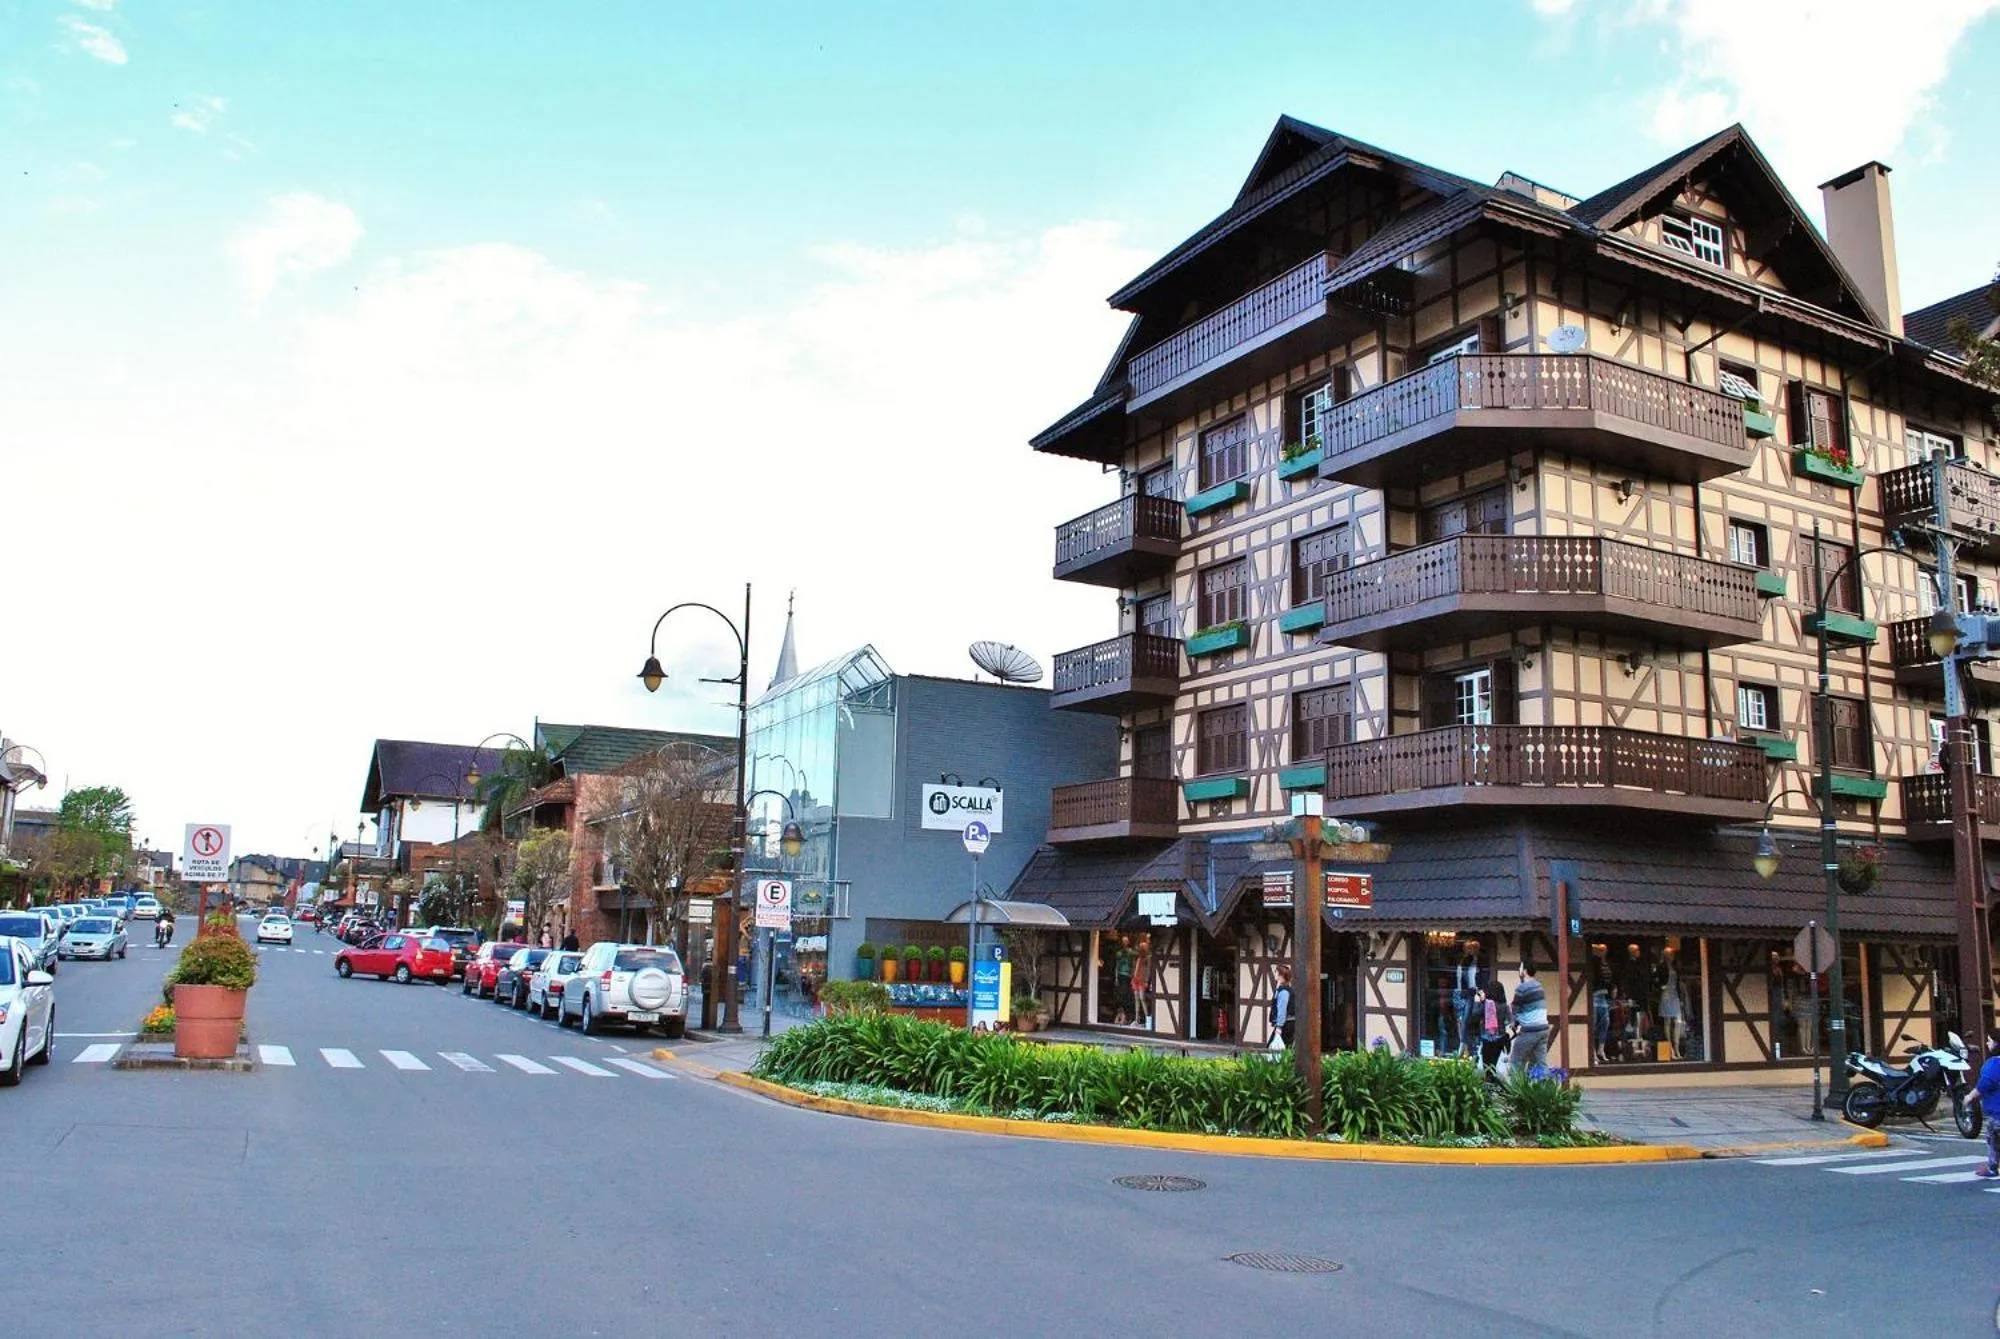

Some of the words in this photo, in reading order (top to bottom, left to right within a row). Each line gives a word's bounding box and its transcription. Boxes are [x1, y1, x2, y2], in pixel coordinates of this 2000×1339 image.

[951, 795, 993, 811] SCALLA
[968, 825, 979, 840] P
[770, 885, 781, 900] E
